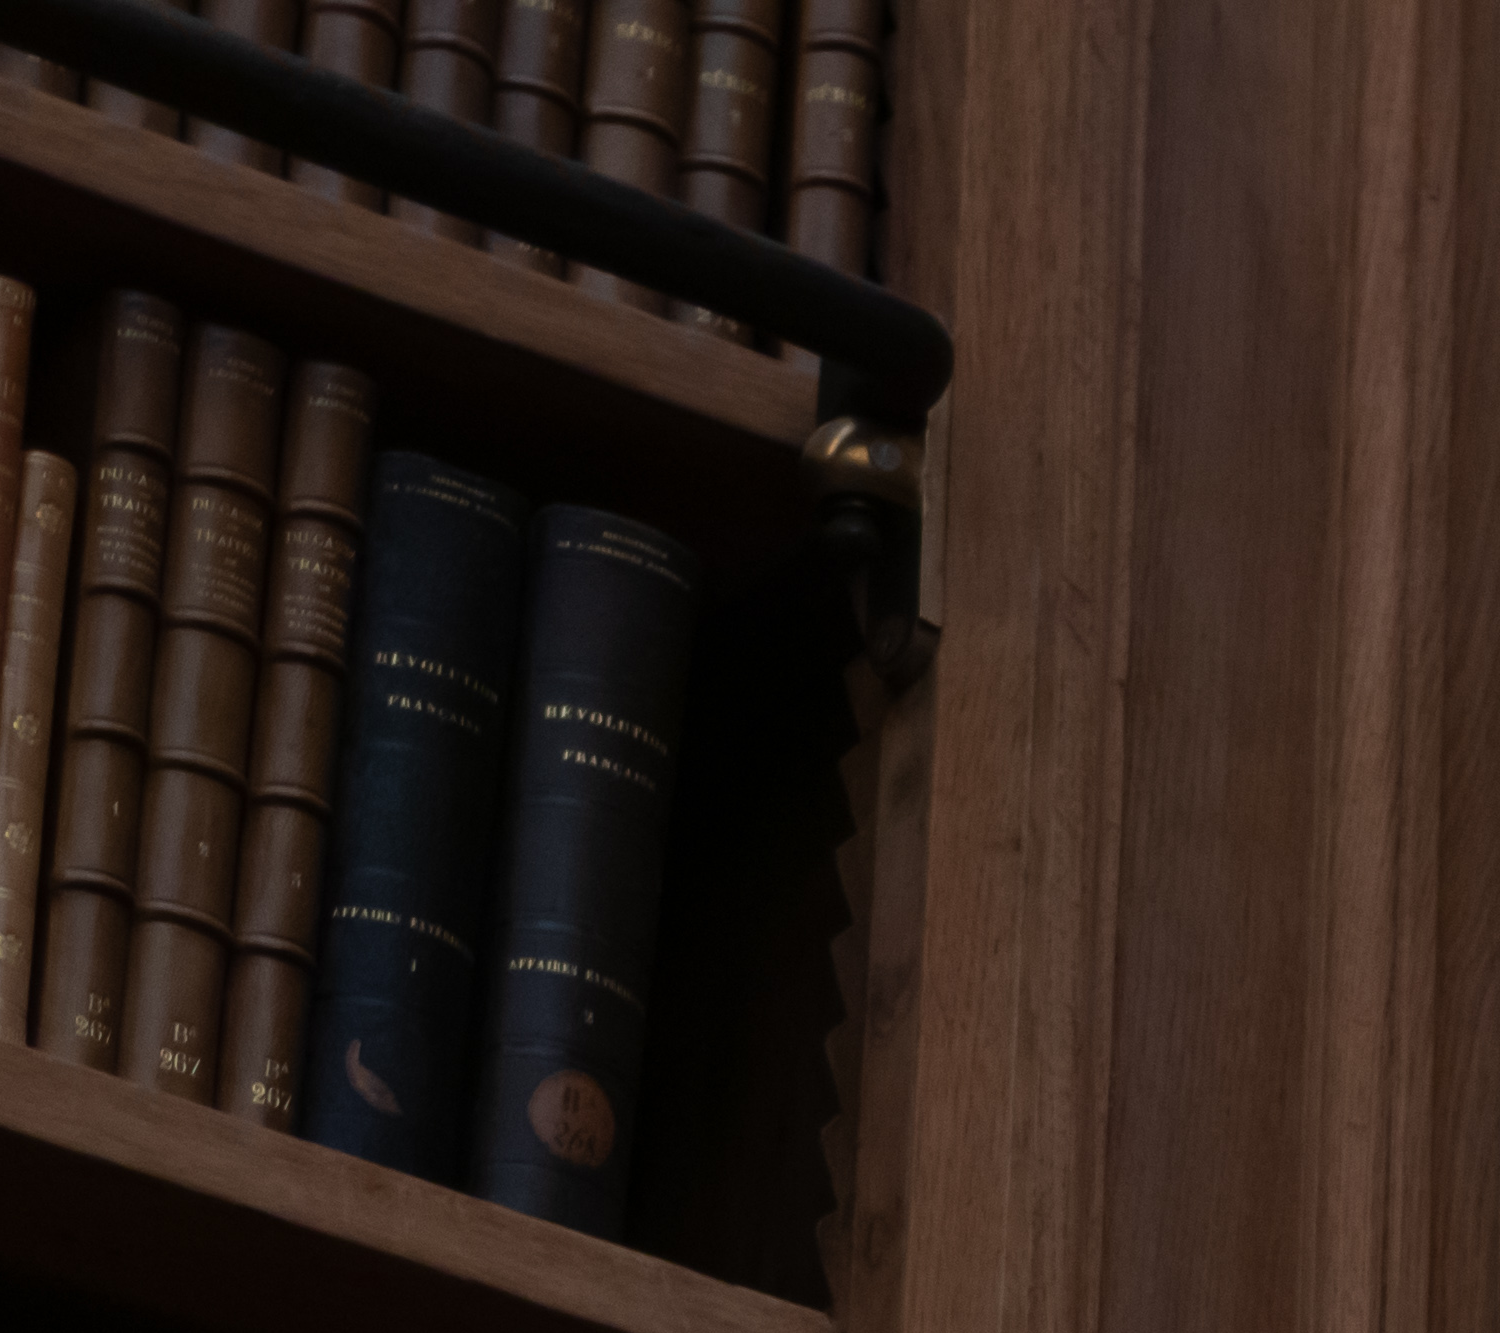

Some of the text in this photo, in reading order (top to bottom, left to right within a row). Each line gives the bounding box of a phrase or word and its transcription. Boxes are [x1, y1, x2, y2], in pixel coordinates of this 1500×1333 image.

[543, 703, 670, 758] RÉVOLUTION
[331, 904, 402, 927] AFFAIRES
[508, 956, 579, 981] AFFAIRES
[74, 1014, 113, 1045] 267
[158, 1046, 203, 1078] 267
[249, 1081, 293, 1114] 267
